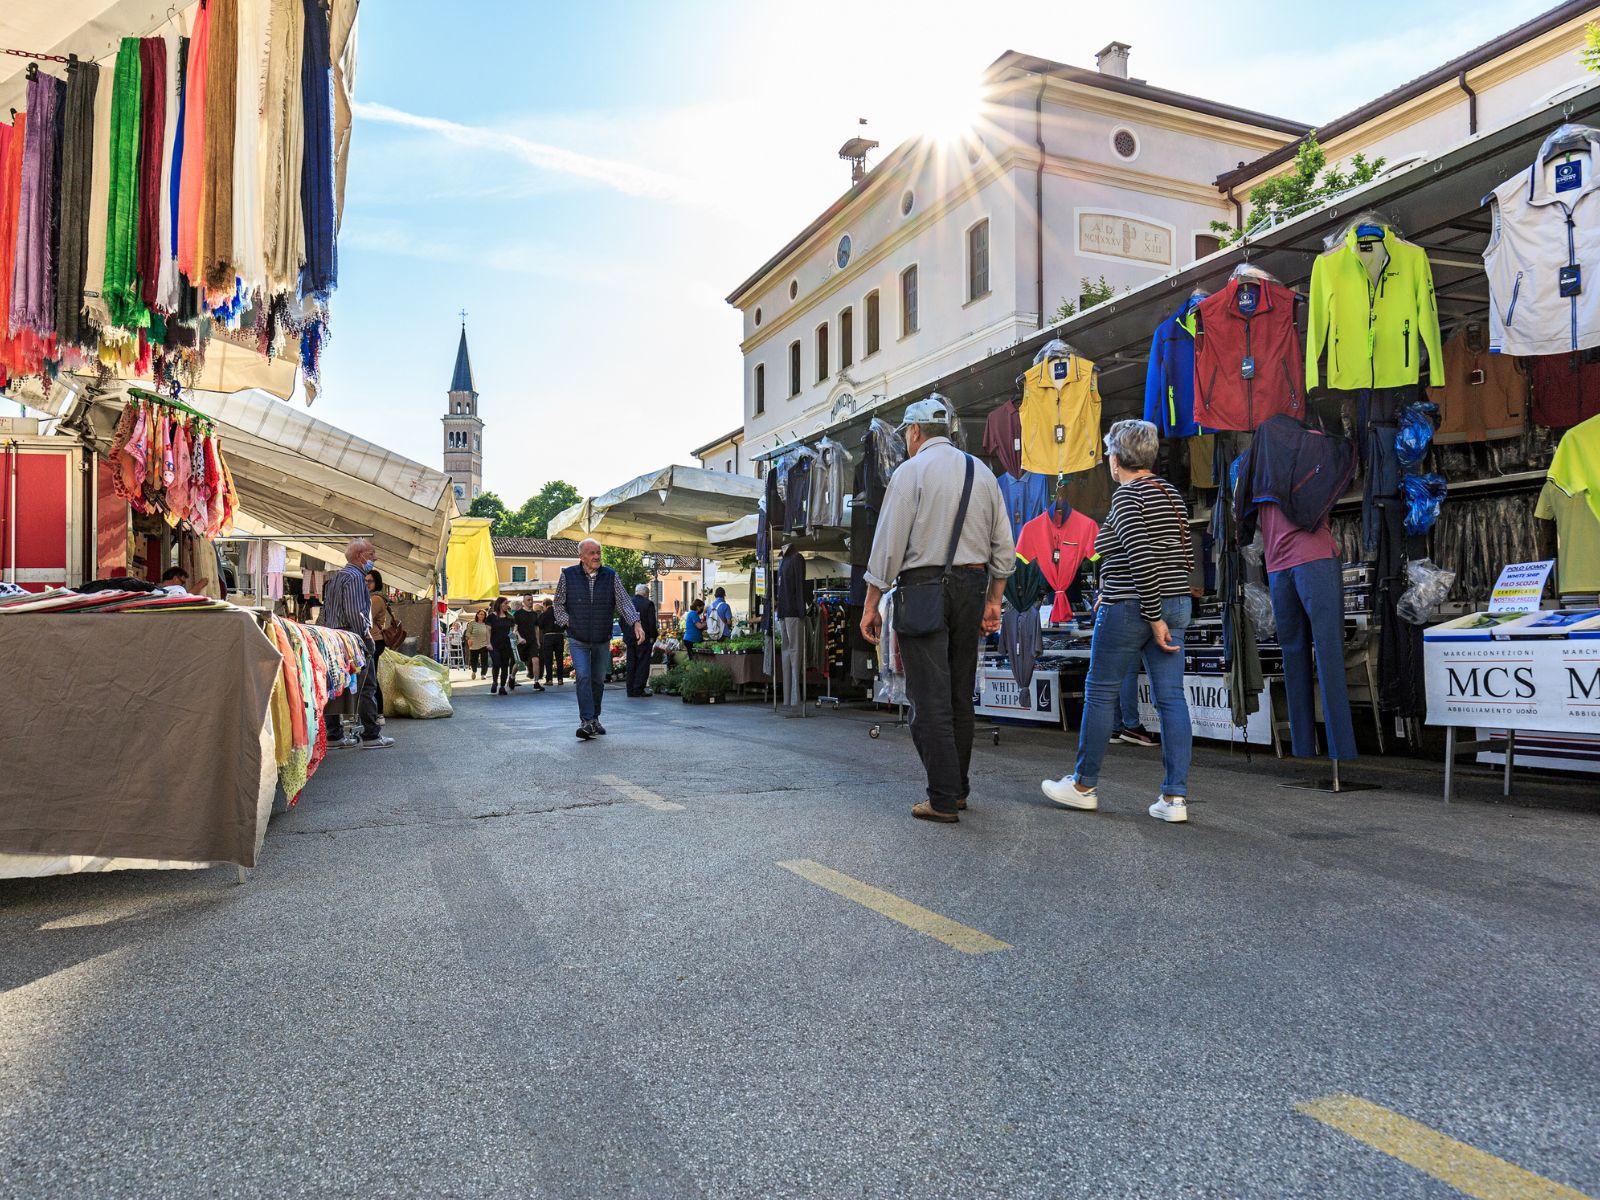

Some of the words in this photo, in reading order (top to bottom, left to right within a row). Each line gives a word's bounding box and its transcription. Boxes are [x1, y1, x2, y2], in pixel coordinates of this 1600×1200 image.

[992, 682, 1021, 693] WHIT
[1446, 667, 1536, 698] MCS
[995, 694, 1020, 705] SHIP
[1447, 706, 1512, 714] ABBIGLIAMENTO
